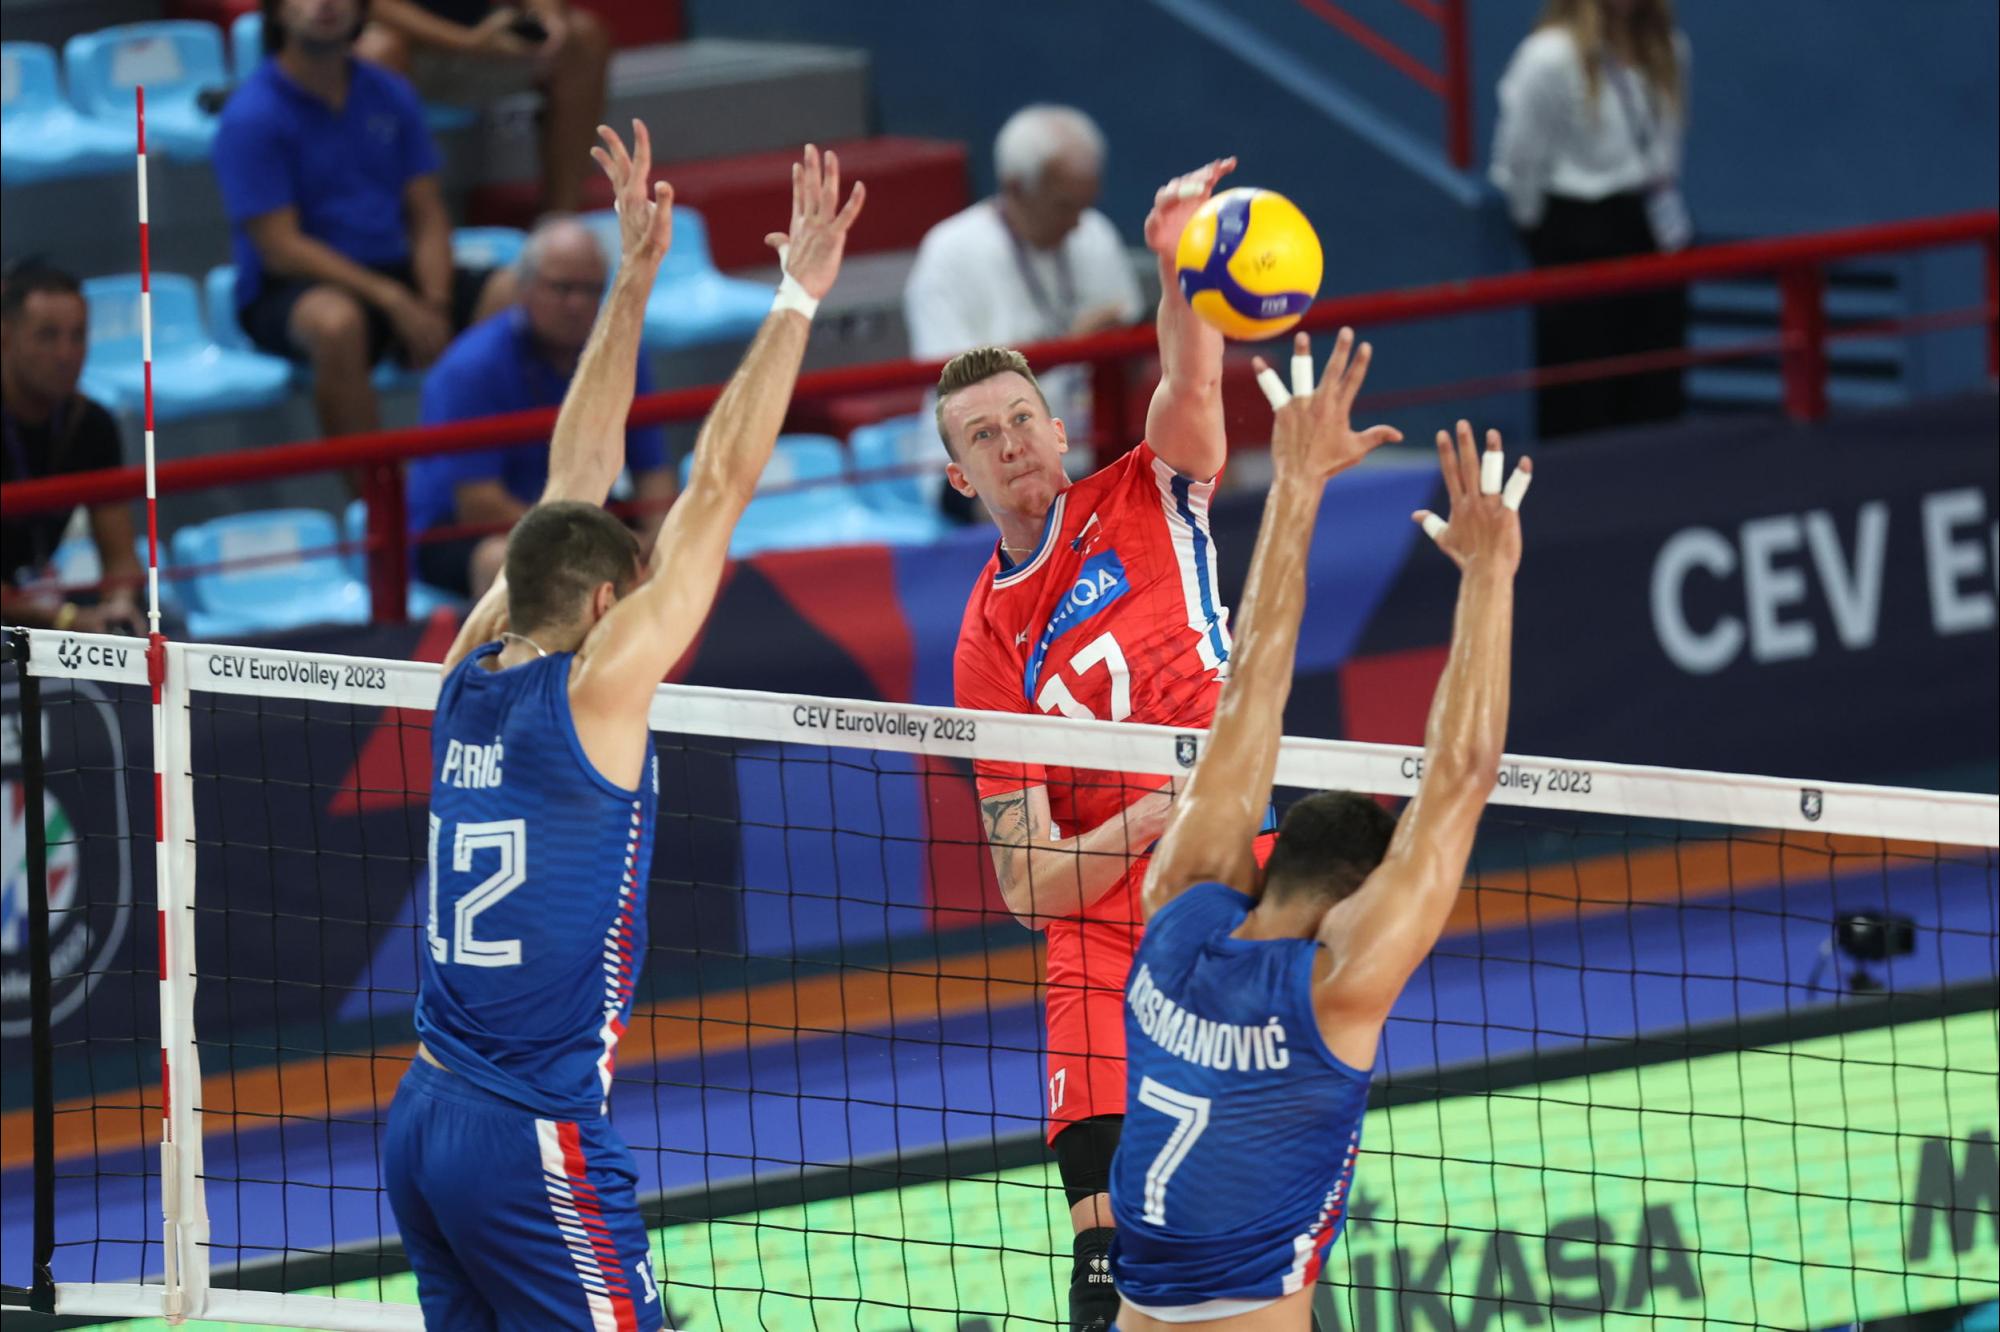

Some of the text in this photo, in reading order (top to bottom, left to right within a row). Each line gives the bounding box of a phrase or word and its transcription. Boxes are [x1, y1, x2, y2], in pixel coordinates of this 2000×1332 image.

[1651, 487, 1998, 674] CEV E
[87, 646, 128, 668] CEV
[208, 654, 386, 690] CEV EuroVolley 2023
[793, 705, 976, 742] CEV EuroVolley 2023
[1401, 757, 1424, 780] CE
[1547, 769, 1593, 794] 2023
[427, 811, 526, 967] 12
[1049, 1067, 1066, 1115] 17
[1138, 1075, 1211, 1226] 7
[1313, 1204, 1702, 1332] IKASA
